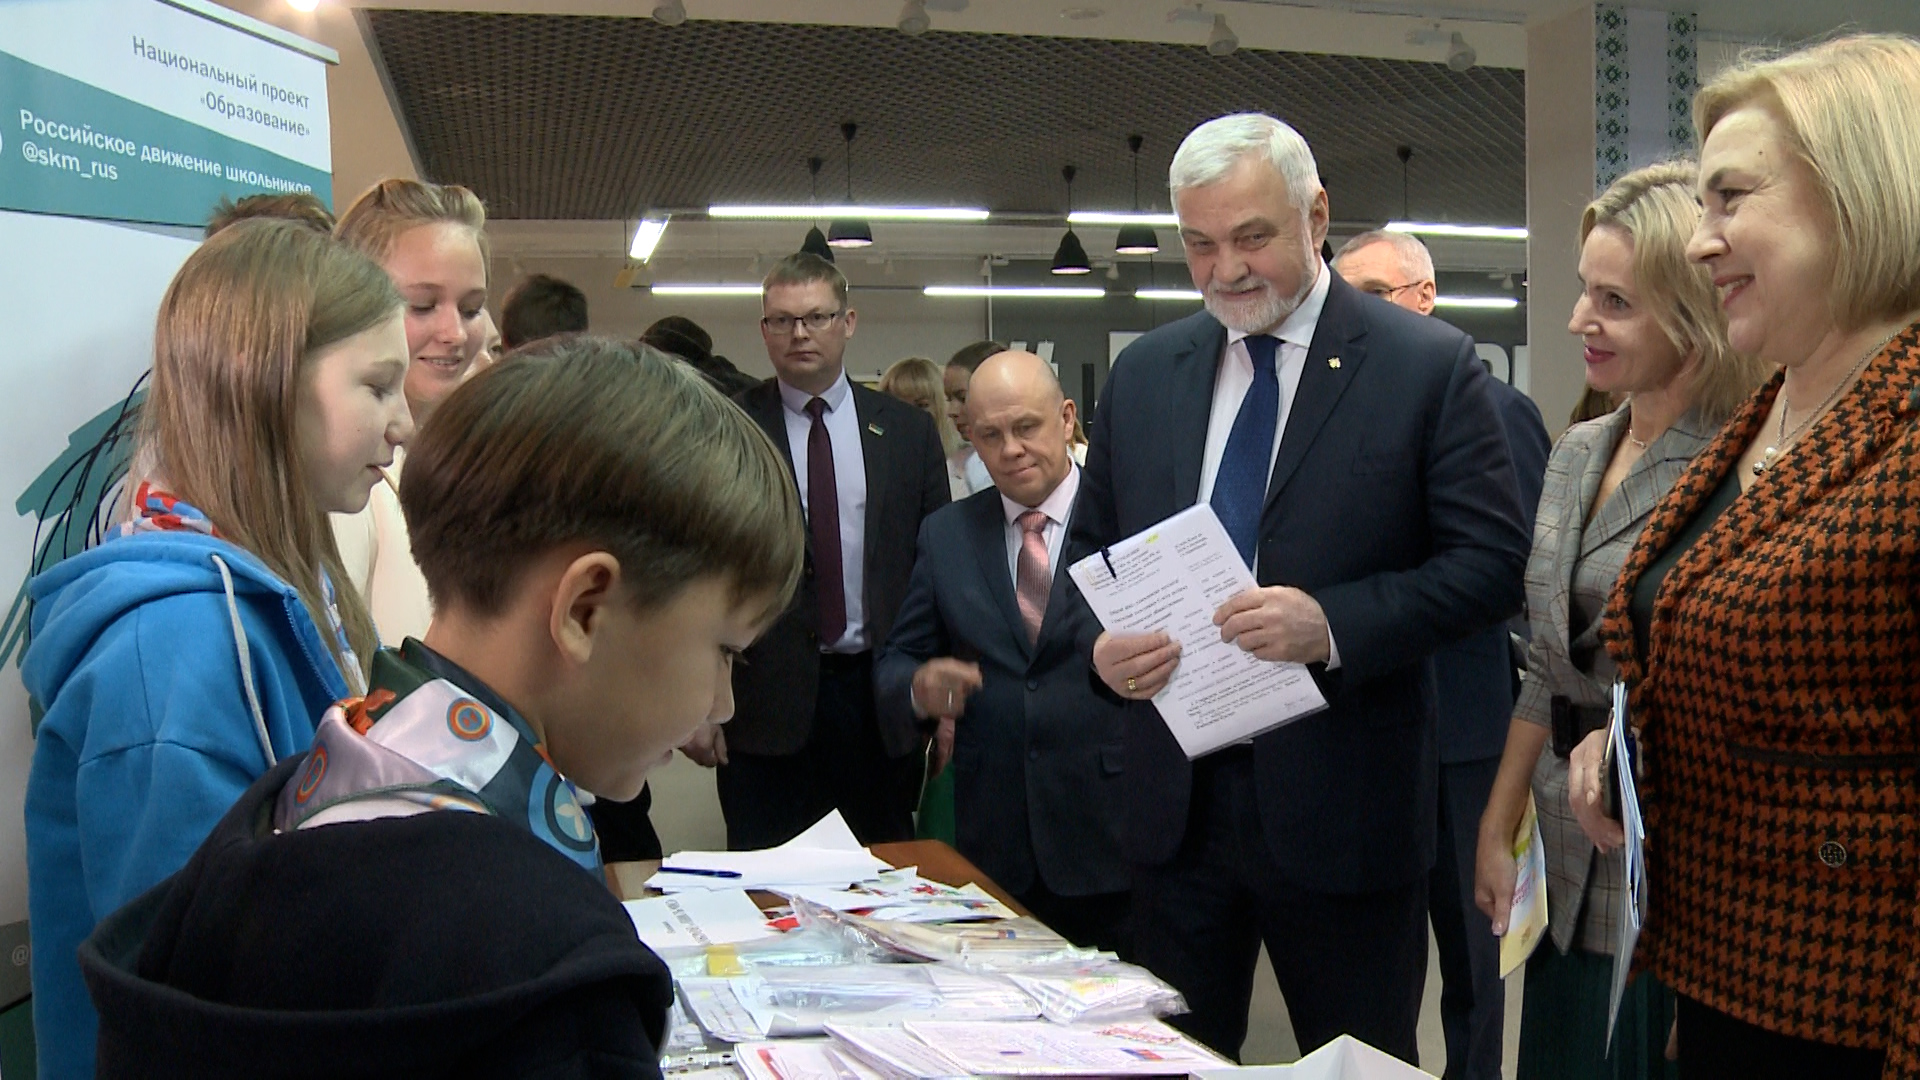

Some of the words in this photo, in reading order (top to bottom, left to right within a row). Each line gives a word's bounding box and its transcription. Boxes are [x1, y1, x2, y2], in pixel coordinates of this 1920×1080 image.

[132, 35, 258, 93] Национальный
[261, 82, 310, 110] проект
[20, 108, 136, 157] Российское
[140, 145, 222, 178] движение
[200, 91, 310, 137] «Образование»
[22, 141, 118, 180] @skm_rus
